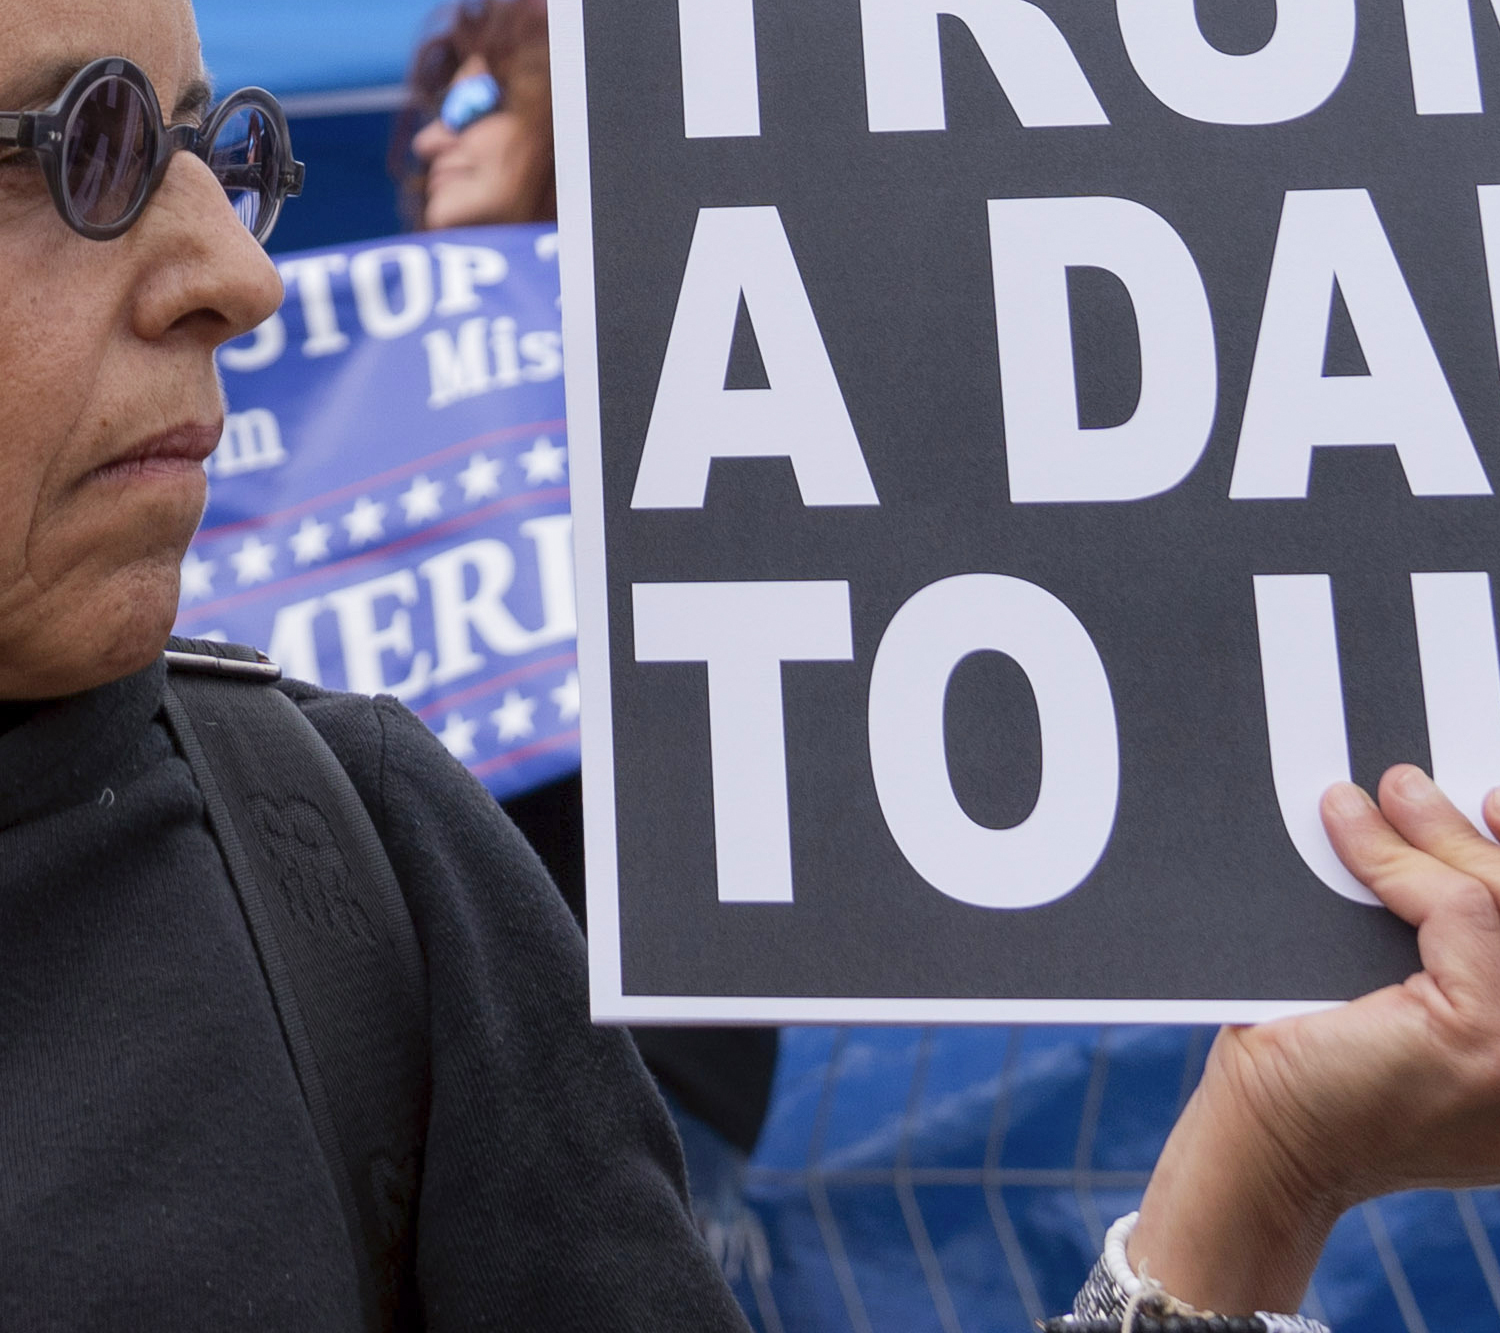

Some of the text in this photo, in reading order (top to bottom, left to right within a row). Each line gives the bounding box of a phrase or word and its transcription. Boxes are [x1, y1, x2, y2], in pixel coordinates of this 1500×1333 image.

[422, 314, 563, 410] Mis
[629, 205, 882, 511] A
[632, 569, 1122, 913] TO
